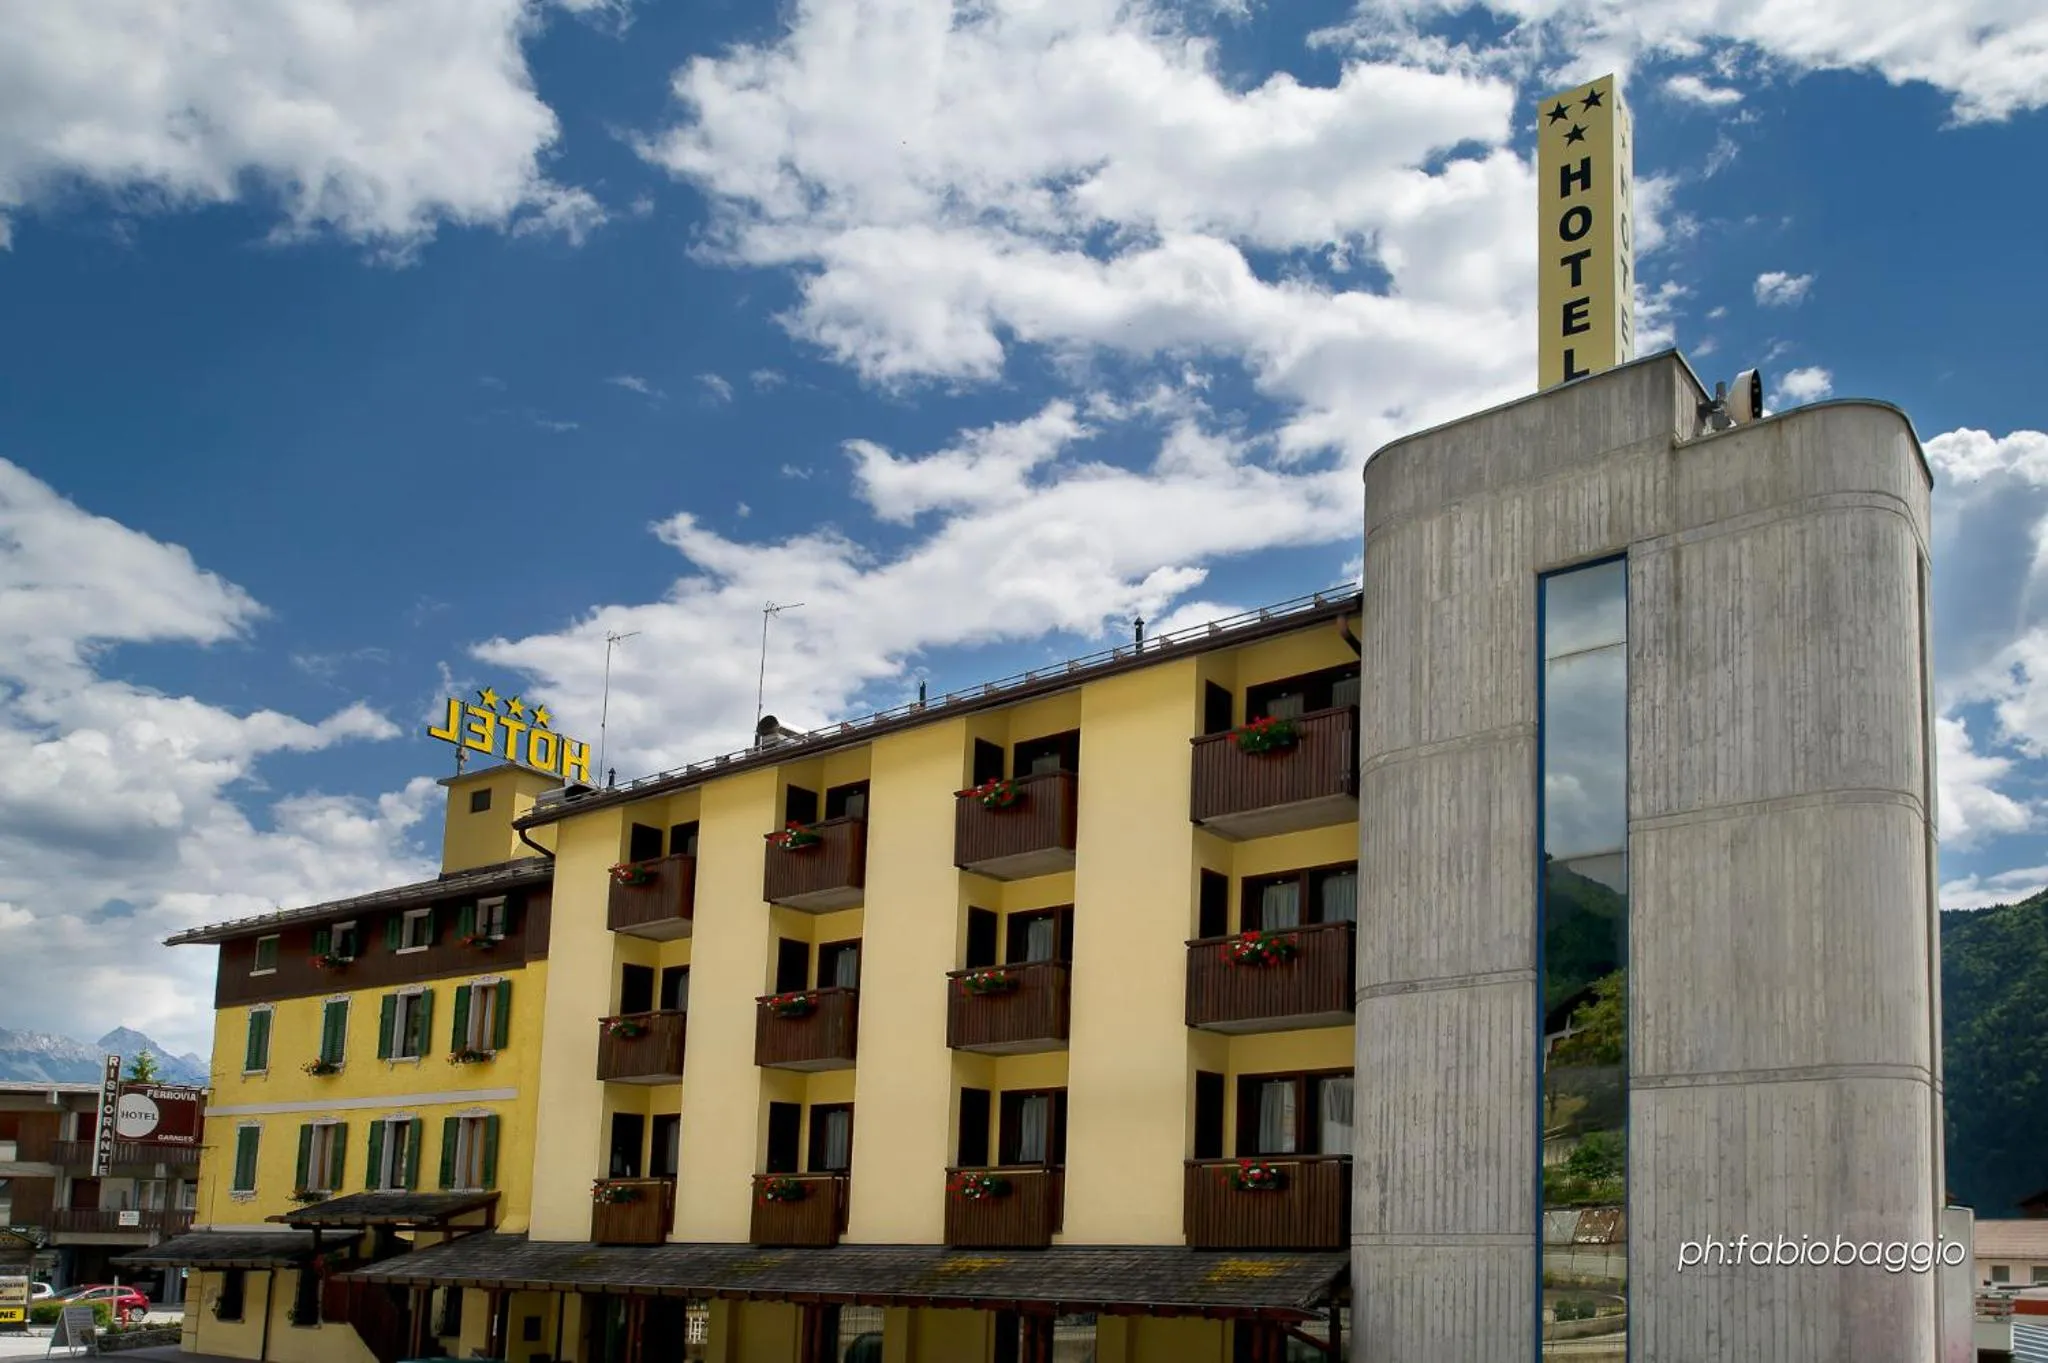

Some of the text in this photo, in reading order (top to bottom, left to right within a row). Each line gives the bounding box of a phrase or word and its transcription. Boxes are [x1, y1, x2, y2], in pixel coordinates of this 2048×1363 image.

[1558, 156, 1592, 383] HOTEL
[98, 1056, 120, 1176] RISTORANTE
[120, 1110, 158, 1121] HOTEL
[146, 1088, 197, 1101] FERROVIA
